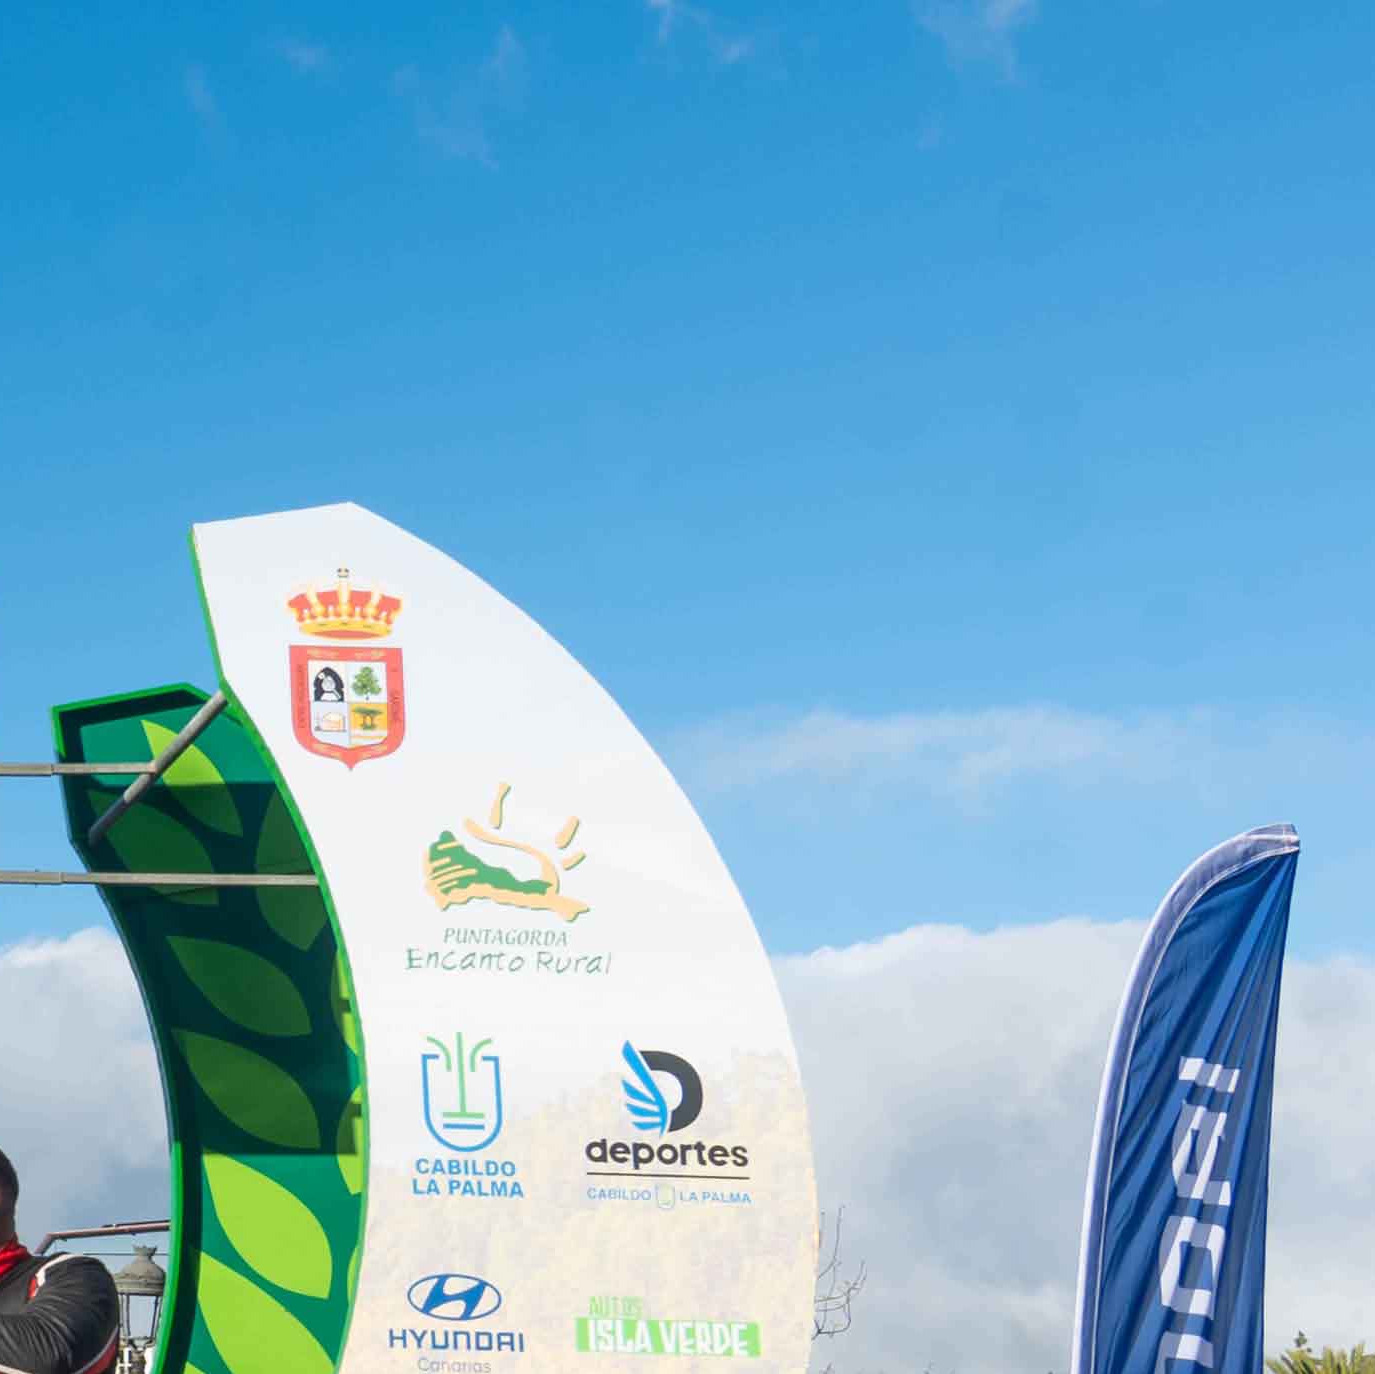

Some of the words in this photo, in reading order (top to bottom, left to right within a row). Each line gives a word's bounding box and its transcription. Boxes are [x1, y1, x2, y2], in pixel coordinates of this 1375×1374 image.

[443, 927, 569, 947] PUNTAGORDA
[405, 948, 526, 973] Encanto
[536, 951, 612, 976] Rural
[585, 1138, 749, 1170] deportes
[415, 1158, 516, 1177] CABILDO
[412, 1179, 441, 1196] LA
[448, 1180, 525, 1198] PALMA
[586, 1186, 652, 1201] CABILDO
[679, 1191, 698, 1203] LA
[702, 1191, 751, 1205] PALMA
[389, 1328, 525, 1353] HYUNDAI
[588, 1319, 652, 1353] ISLA
[658, 1320, 749, 1357] VERDE
[417, 1357, 492, 1374] Canarias
